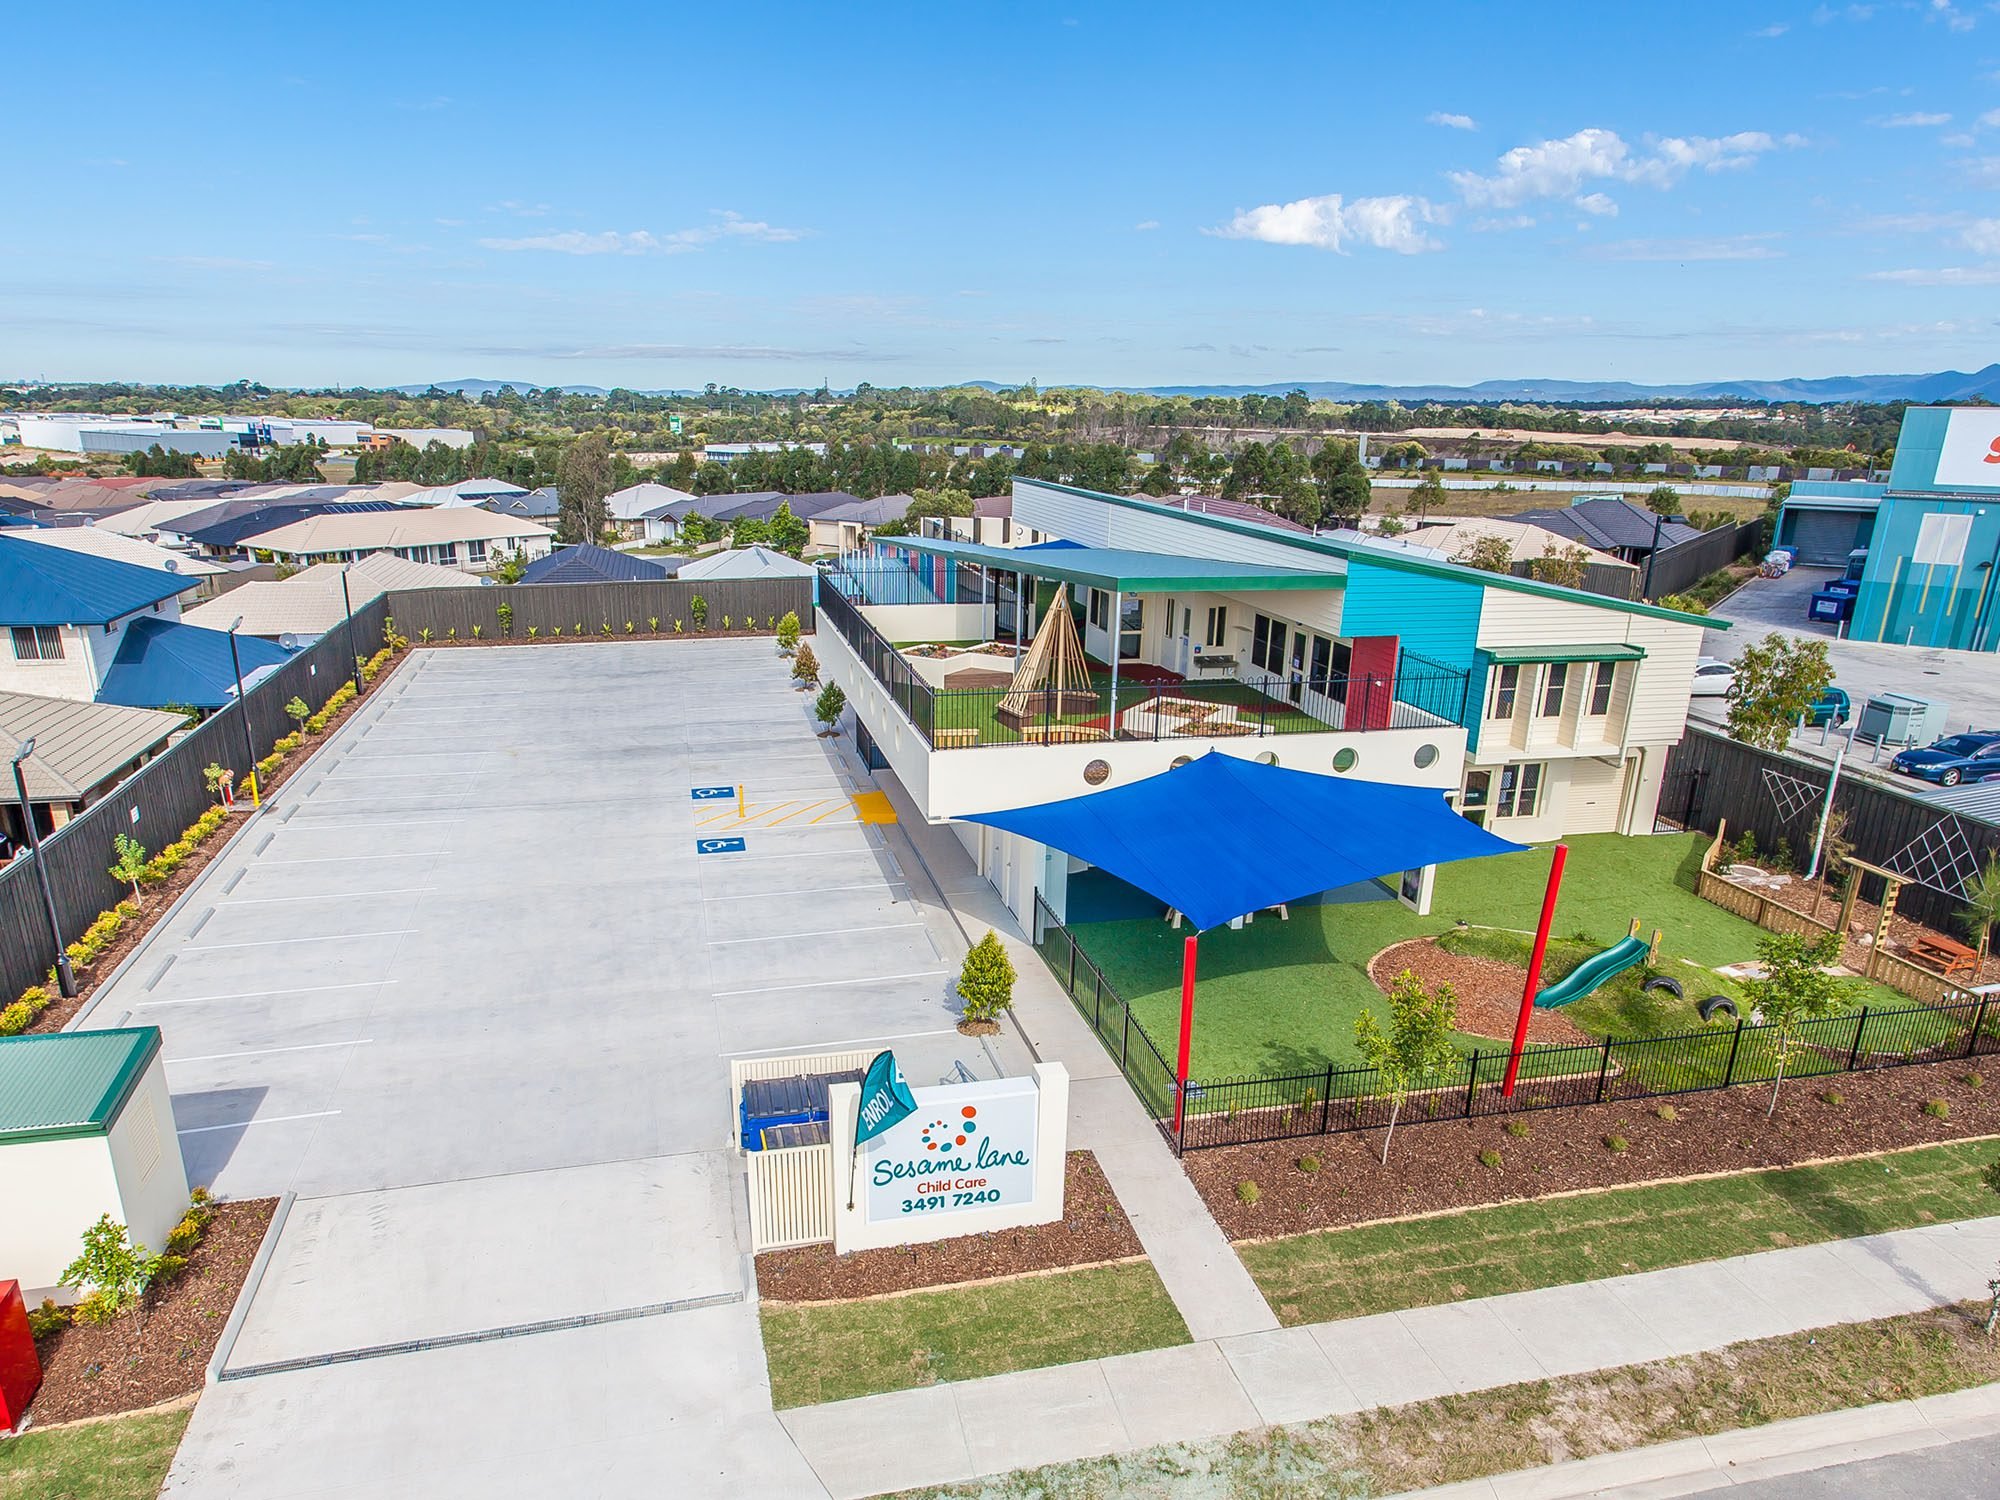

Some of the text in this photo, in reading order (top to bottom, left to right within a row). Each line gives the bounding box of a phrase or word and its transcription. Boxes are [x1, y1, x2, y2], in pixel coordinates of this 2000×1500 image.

[861, 1088, 894, 1131] ENROL
[873, 1136, 1029, 1187] Sesame lane
[902, 1189, 1001, 1213] 3491 7240
[917, 1178, 987, 1194] Child Care
